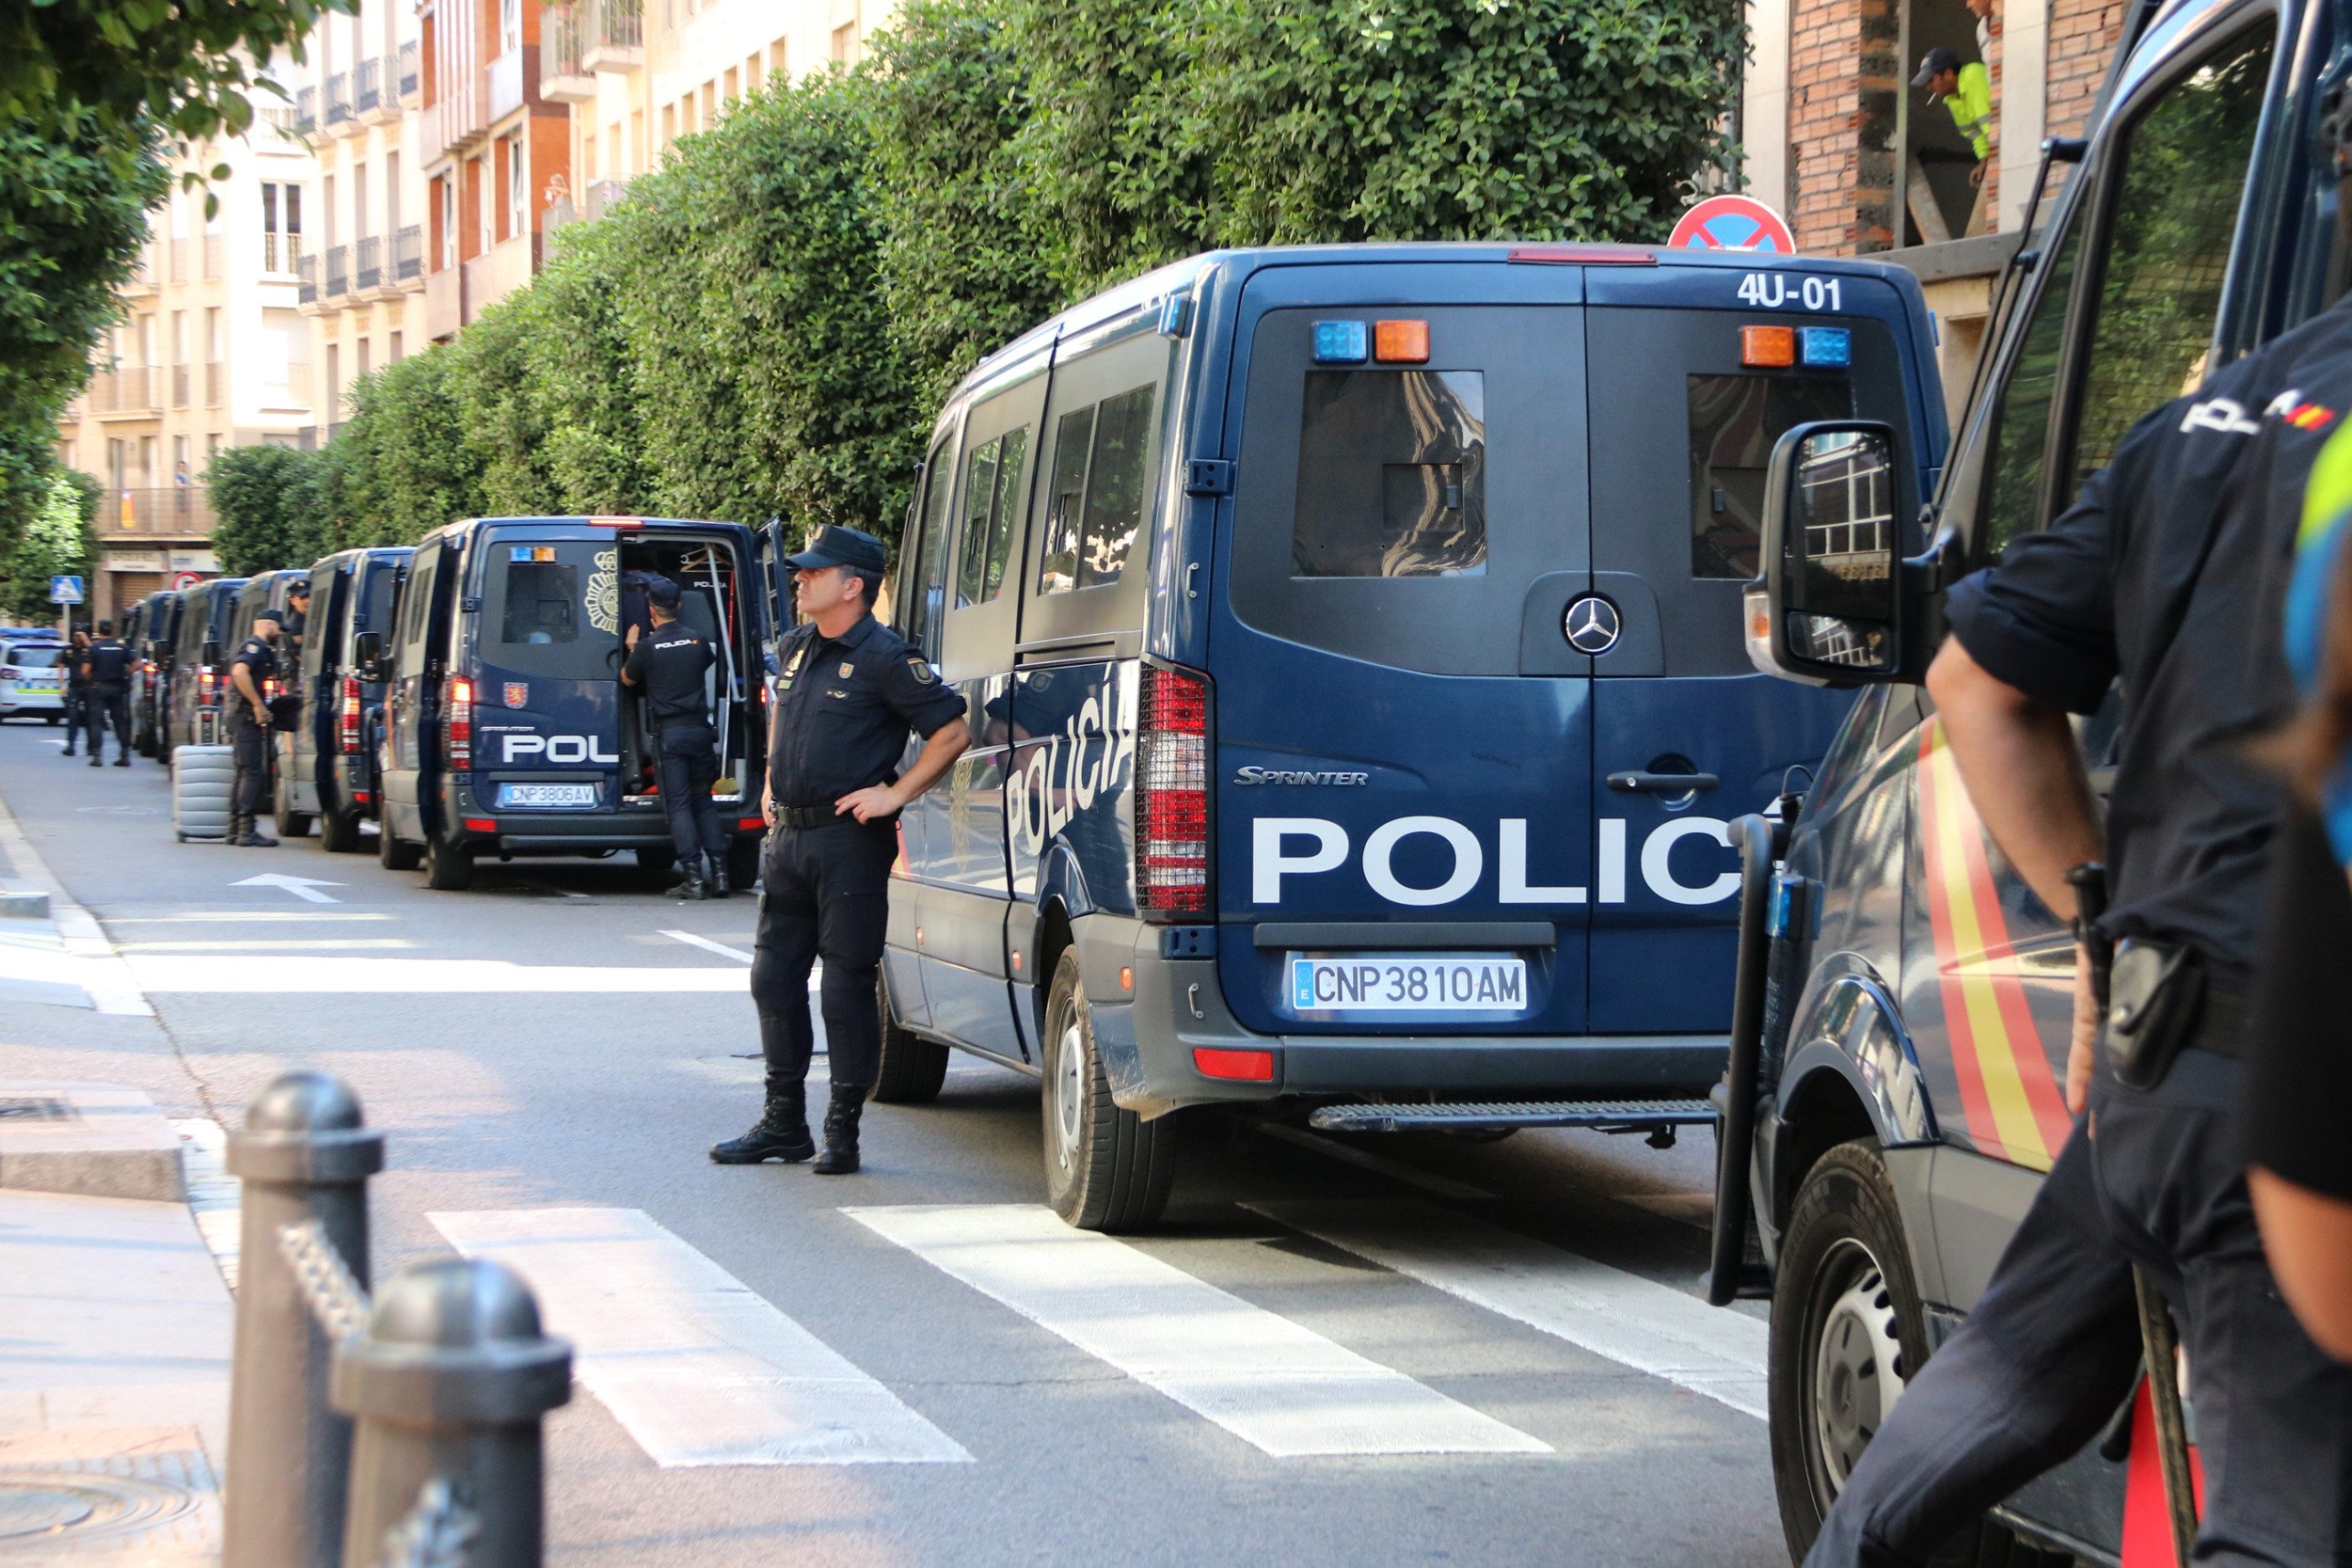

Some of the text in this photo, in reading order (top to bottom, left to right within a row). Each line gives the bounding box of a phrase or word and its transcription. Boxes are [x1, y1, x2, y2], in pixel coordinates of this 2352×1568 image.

[1737, 273, 1840, 311] 4U-01
[502, 735, 620, 763] POL
[1233, 766, 1369, 786] SPRINTER
[1252, 796, 1785, 906] POLIC
[1300, 966, 1520, 1003] E CNP3810AM
